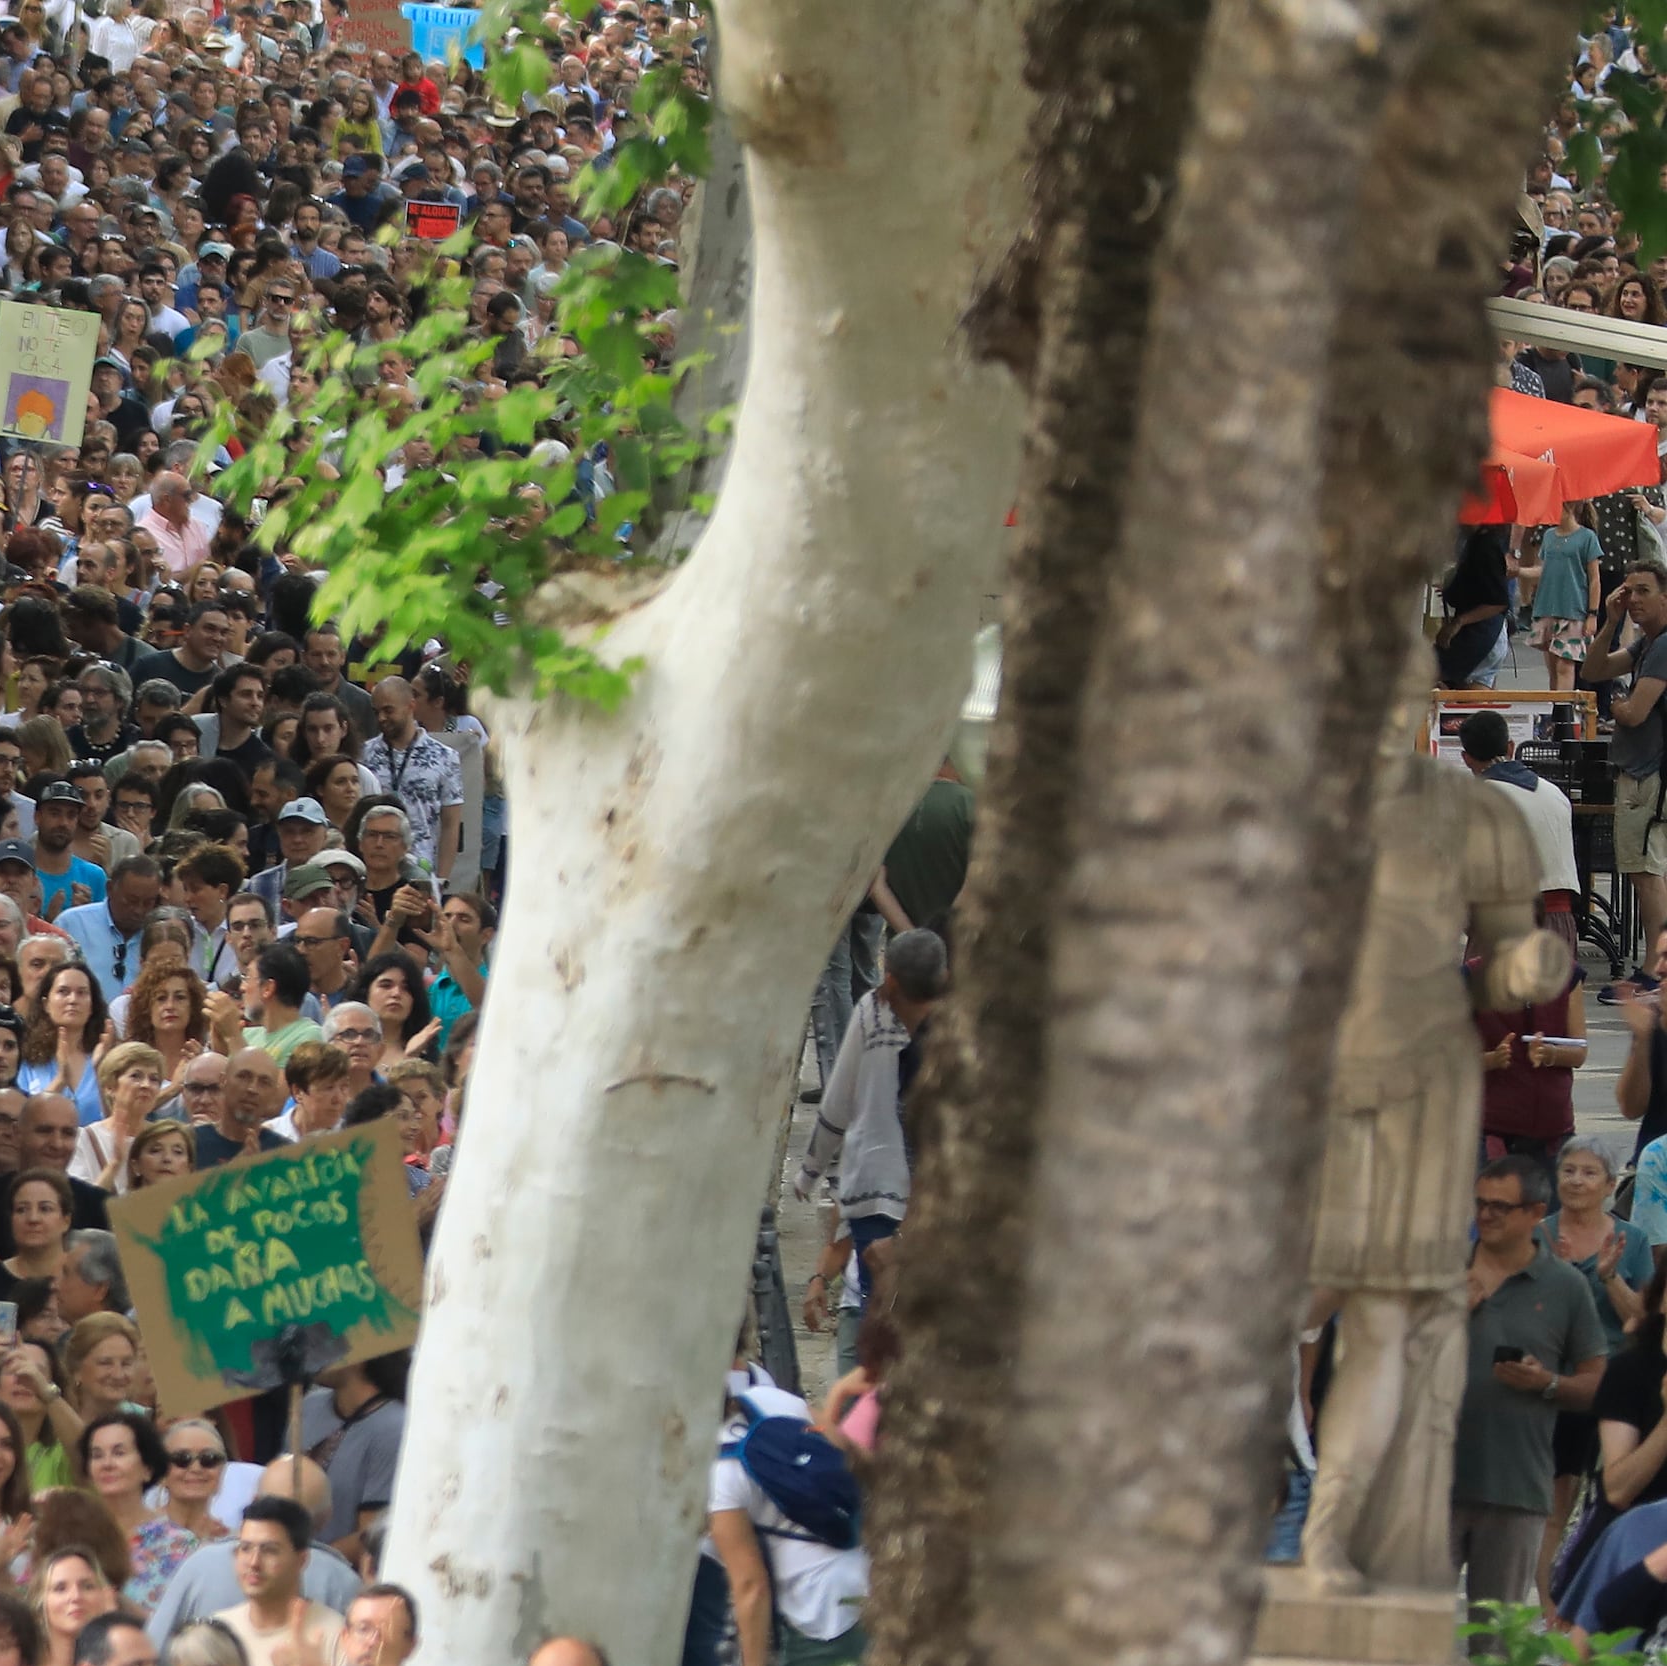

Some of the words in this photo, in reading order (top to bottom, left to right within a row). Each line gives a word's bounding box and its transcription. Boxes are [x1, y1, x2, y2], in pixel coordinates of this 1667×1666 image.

[170, 1201, 210, 1234] LA
[204, 1224, 238, 1255] DE
[251, 1190, 349, 1237] POCOS
[183, 1236, 301, 1302] DAÑA
[223, 1296, 256, 1331] A
[261, 1259, 376, 1326] MUCHOS
